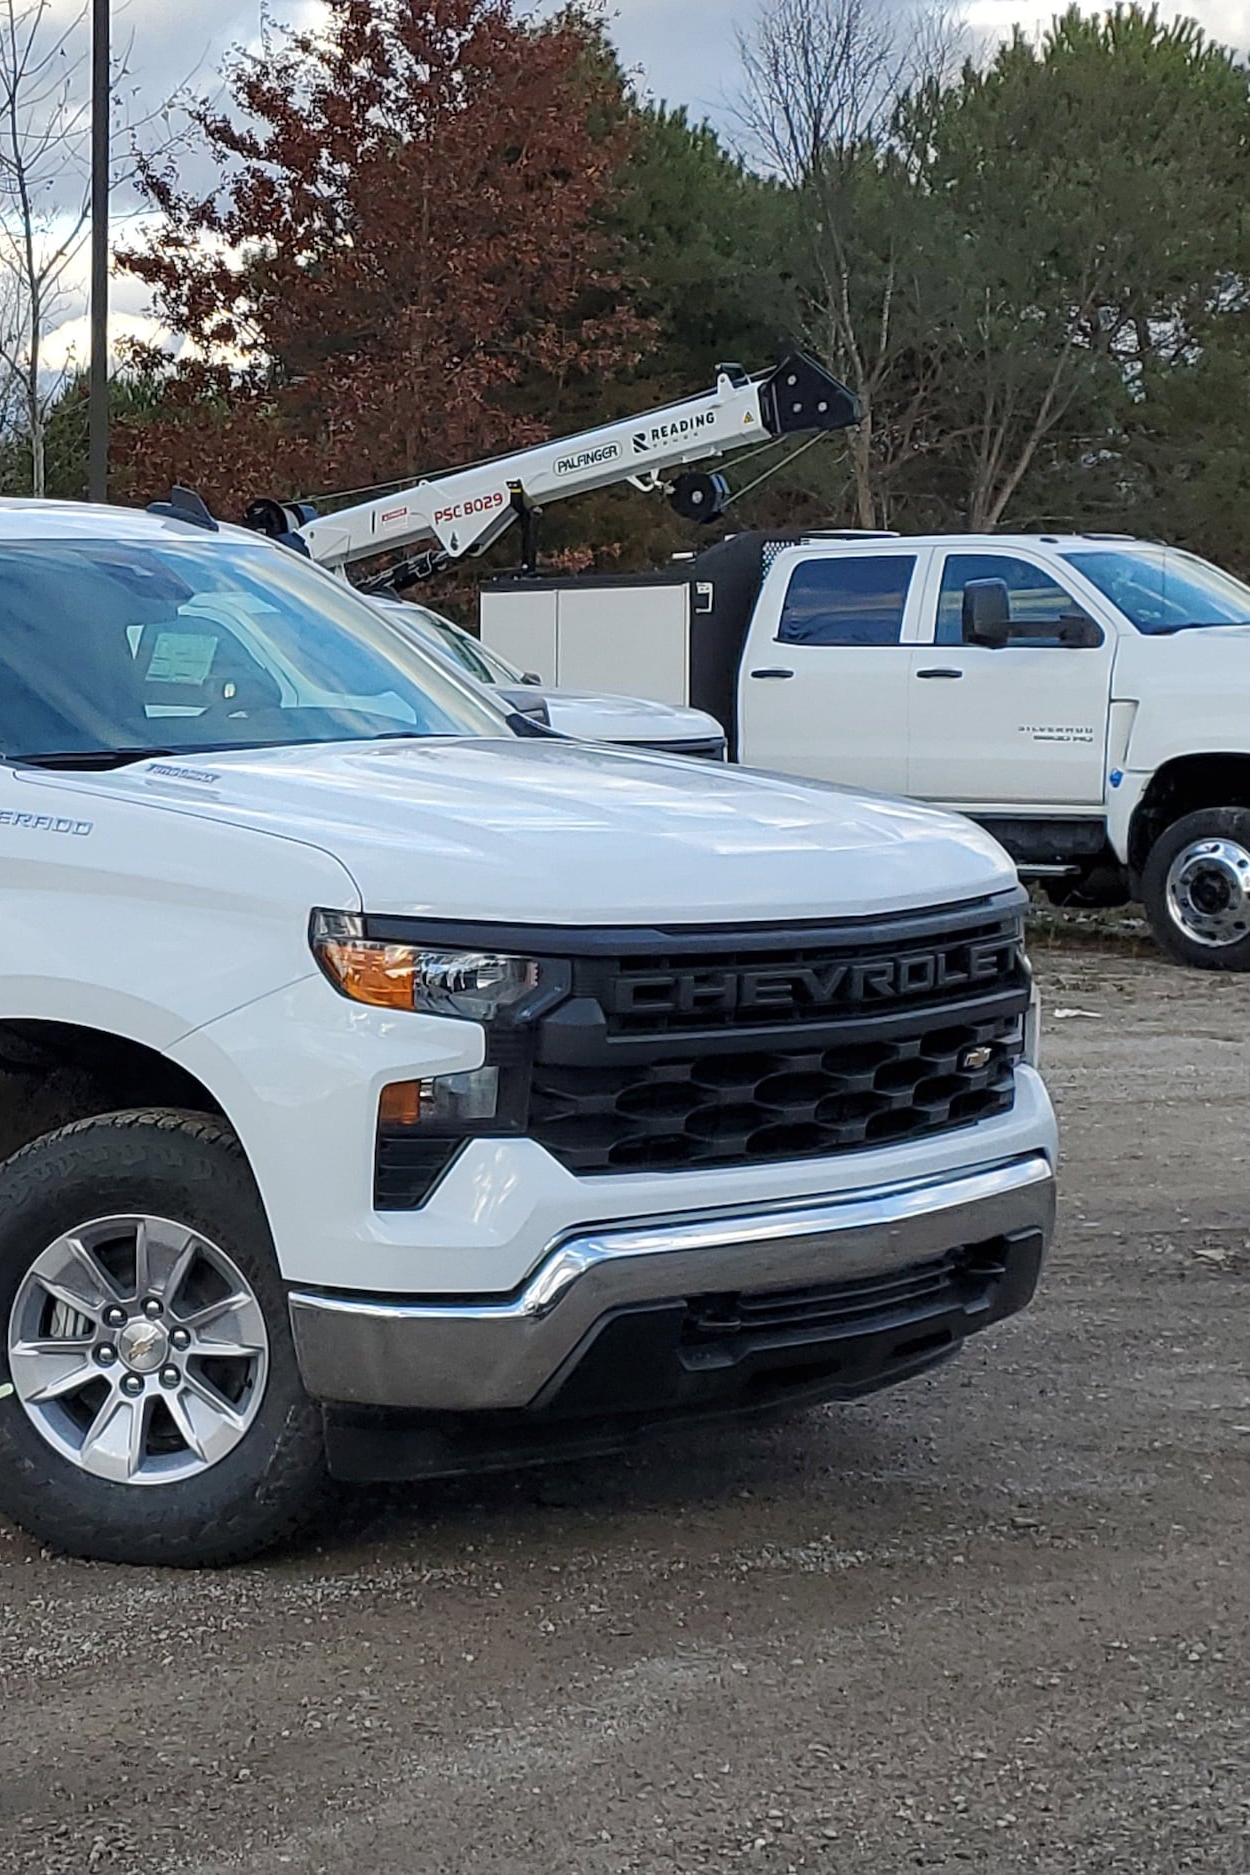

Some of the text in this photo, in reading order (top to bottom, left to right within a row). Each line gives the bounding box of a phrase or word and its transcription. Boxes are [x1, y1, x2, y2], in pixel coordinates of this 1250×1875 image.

[651, 412, 715, 442] READING
[557, 445, 618, 473] PALFINGER
[434, 493, 503, 525] PSC 8029
